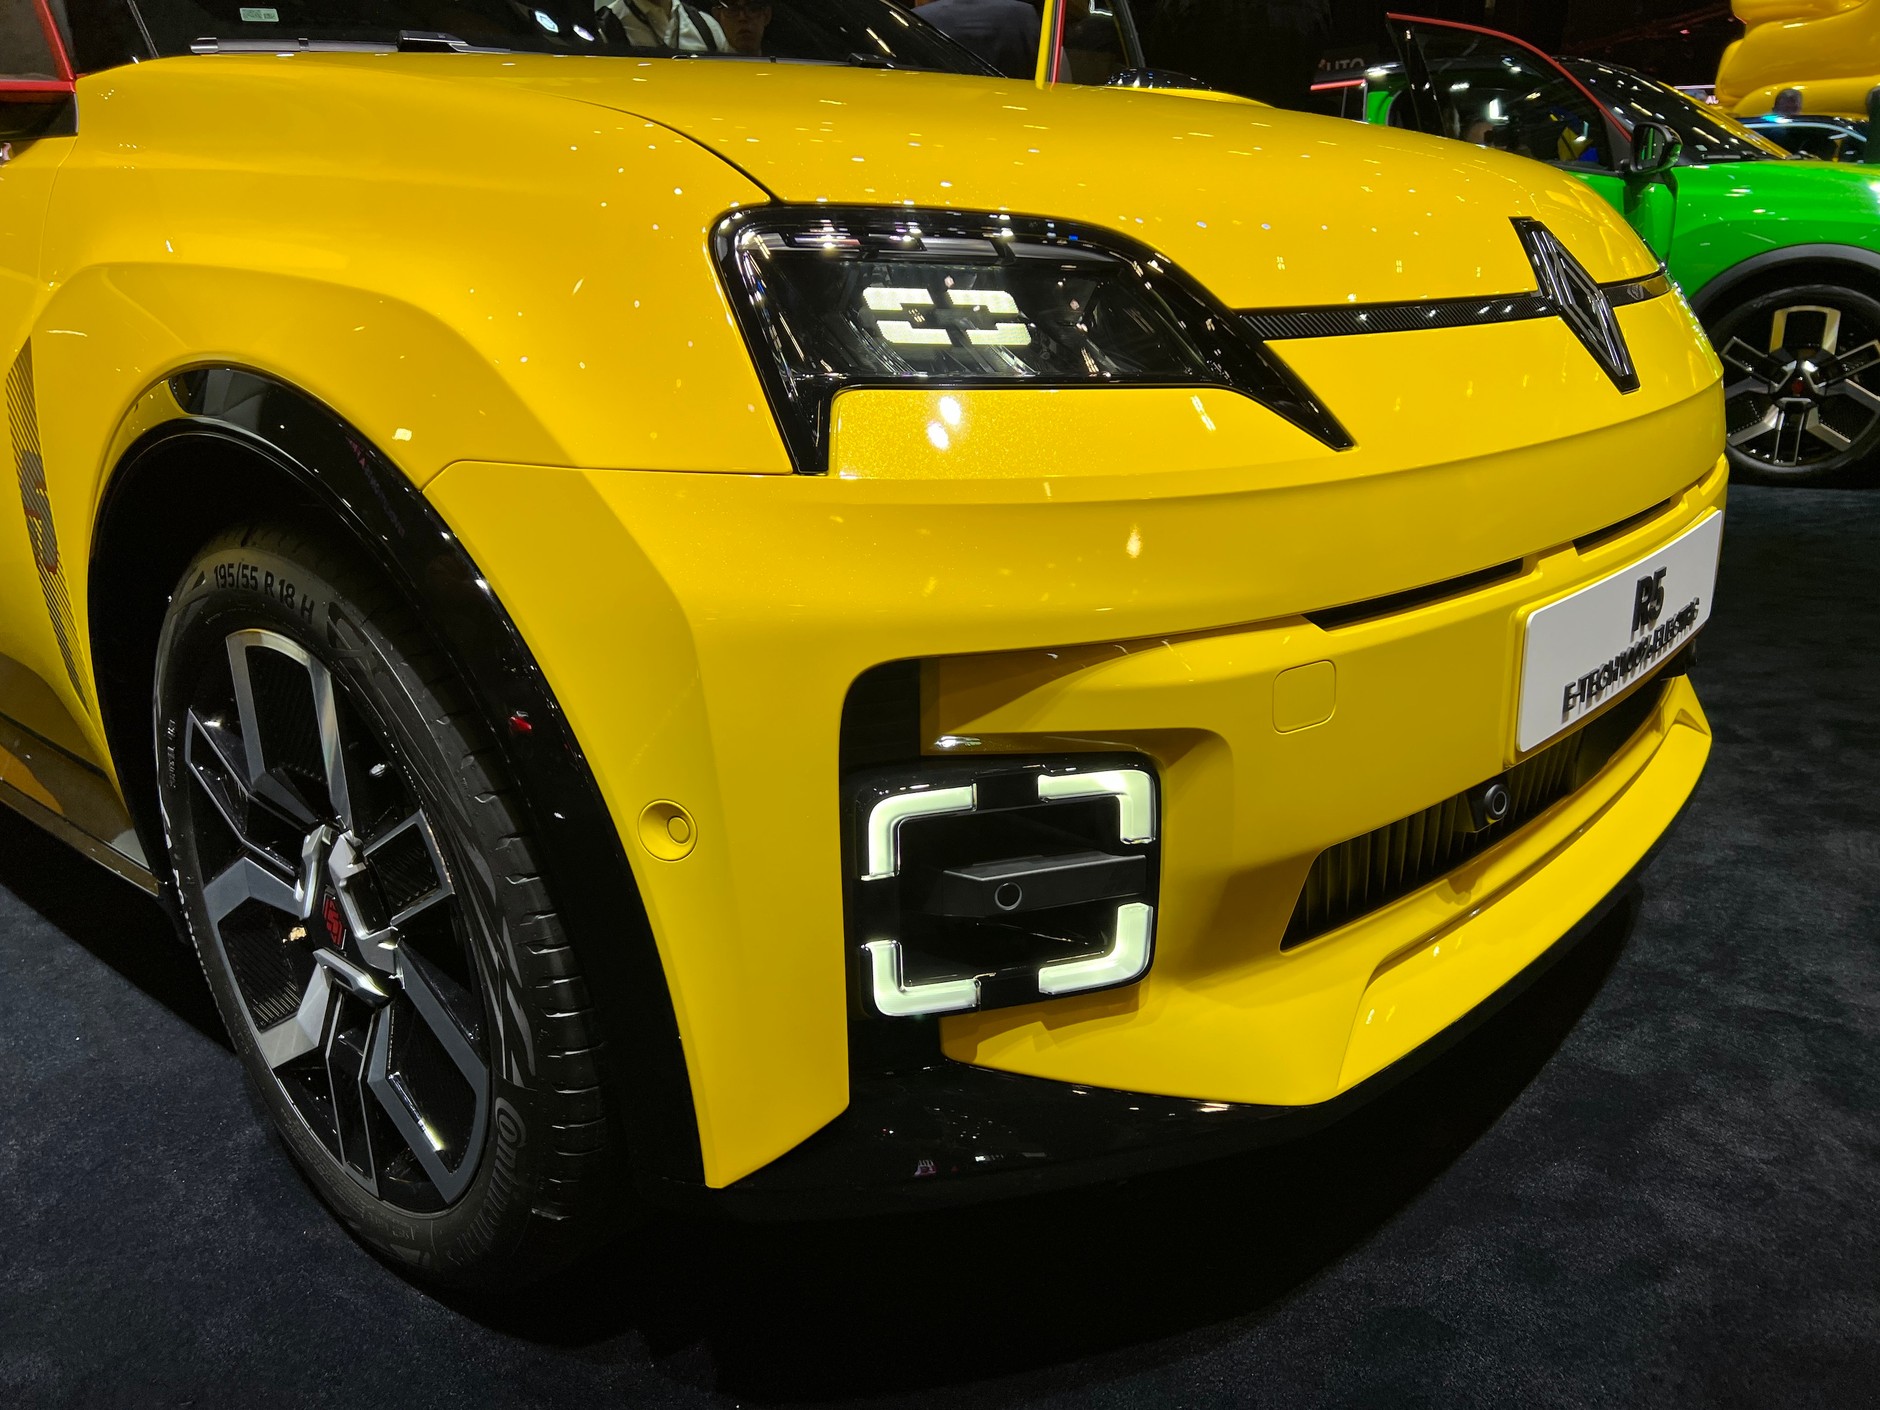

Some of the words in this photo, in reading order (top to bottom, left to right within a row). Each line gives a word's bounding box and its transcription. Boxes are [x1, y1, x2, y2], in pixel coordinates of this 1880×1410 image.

[213, 561, 259, 592] 195/55
[264, 570, 275, 599] R
[279, 579, 296, 610] 18
[301, 593, 315, 625] H
[1632, 566, 1667, 633] R5
[1562, 656, 1620, 713] E-TECH
